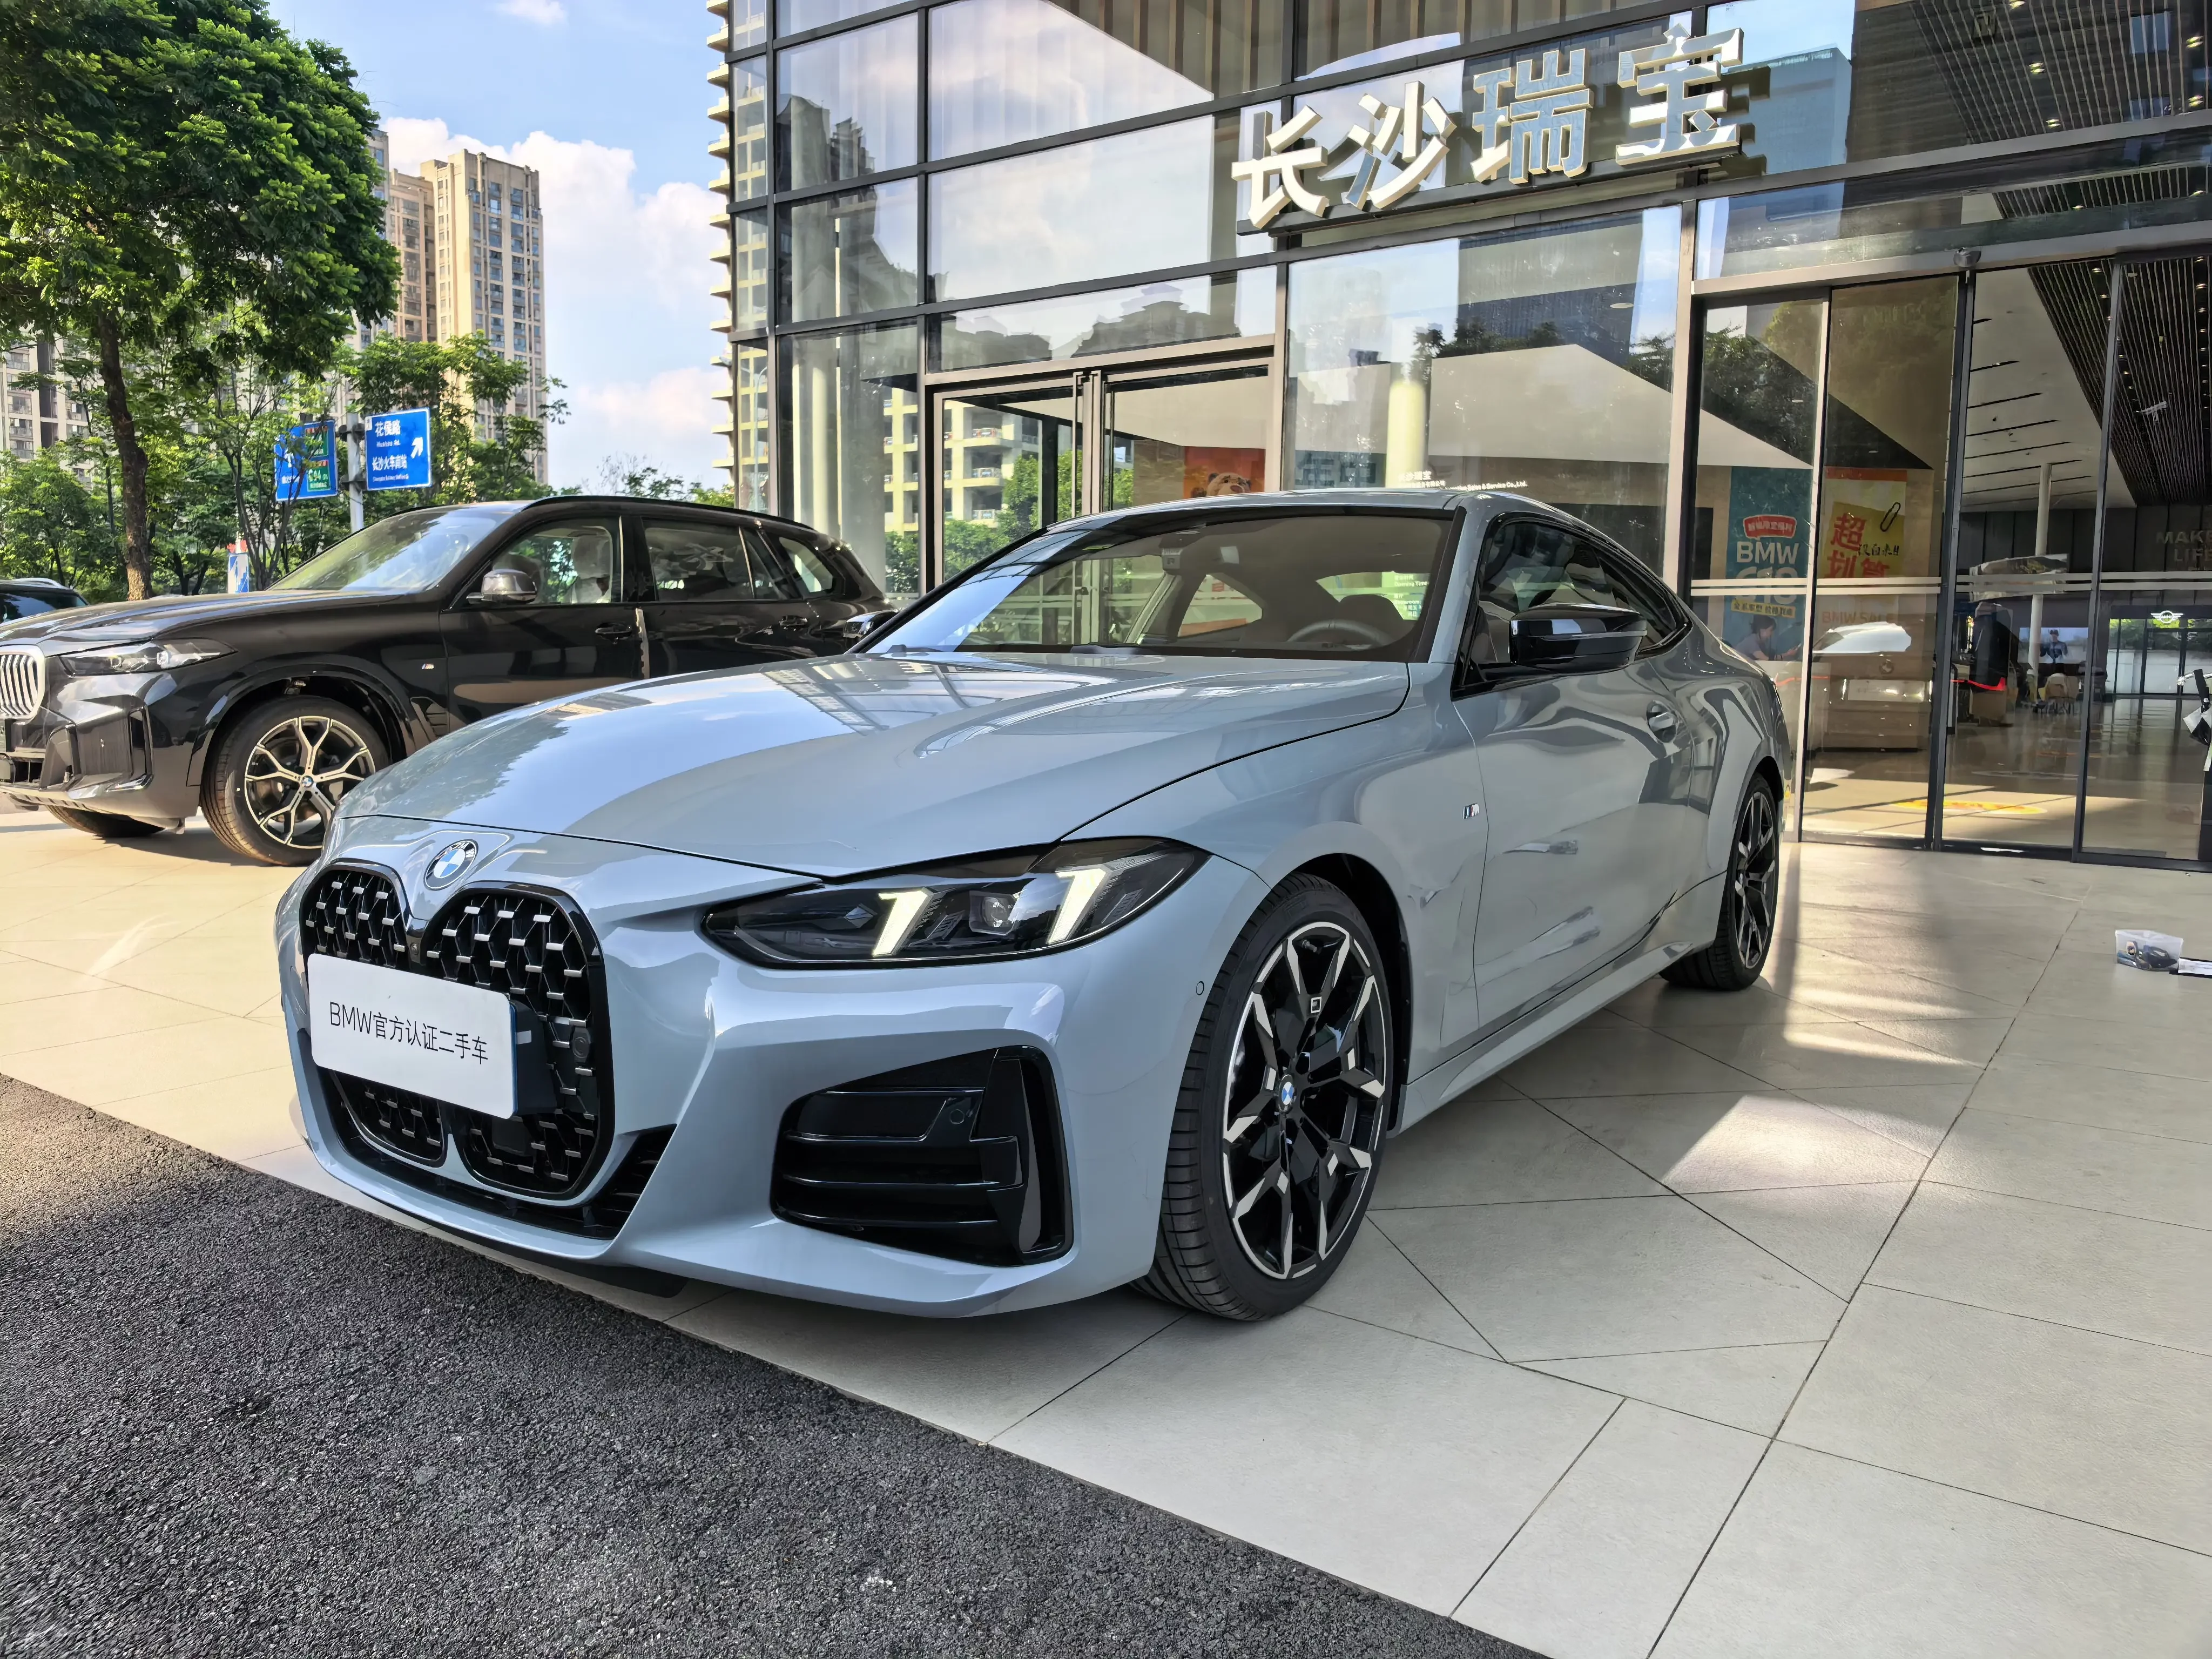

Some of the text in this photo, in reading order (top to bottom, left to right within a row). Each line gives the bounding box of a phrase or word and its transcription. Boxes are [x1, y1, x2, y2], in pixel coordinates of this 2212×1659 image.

[1232, 23, 1743, 229] 长沙瑞宝
[372, 454, 407, 471] 长沙火车南站
[1736, 541, 1799, 564] BMW
[1822, 611, 1857, 623] BMW
[329, 1002, 489, 1064] BMW官方认证二手车
